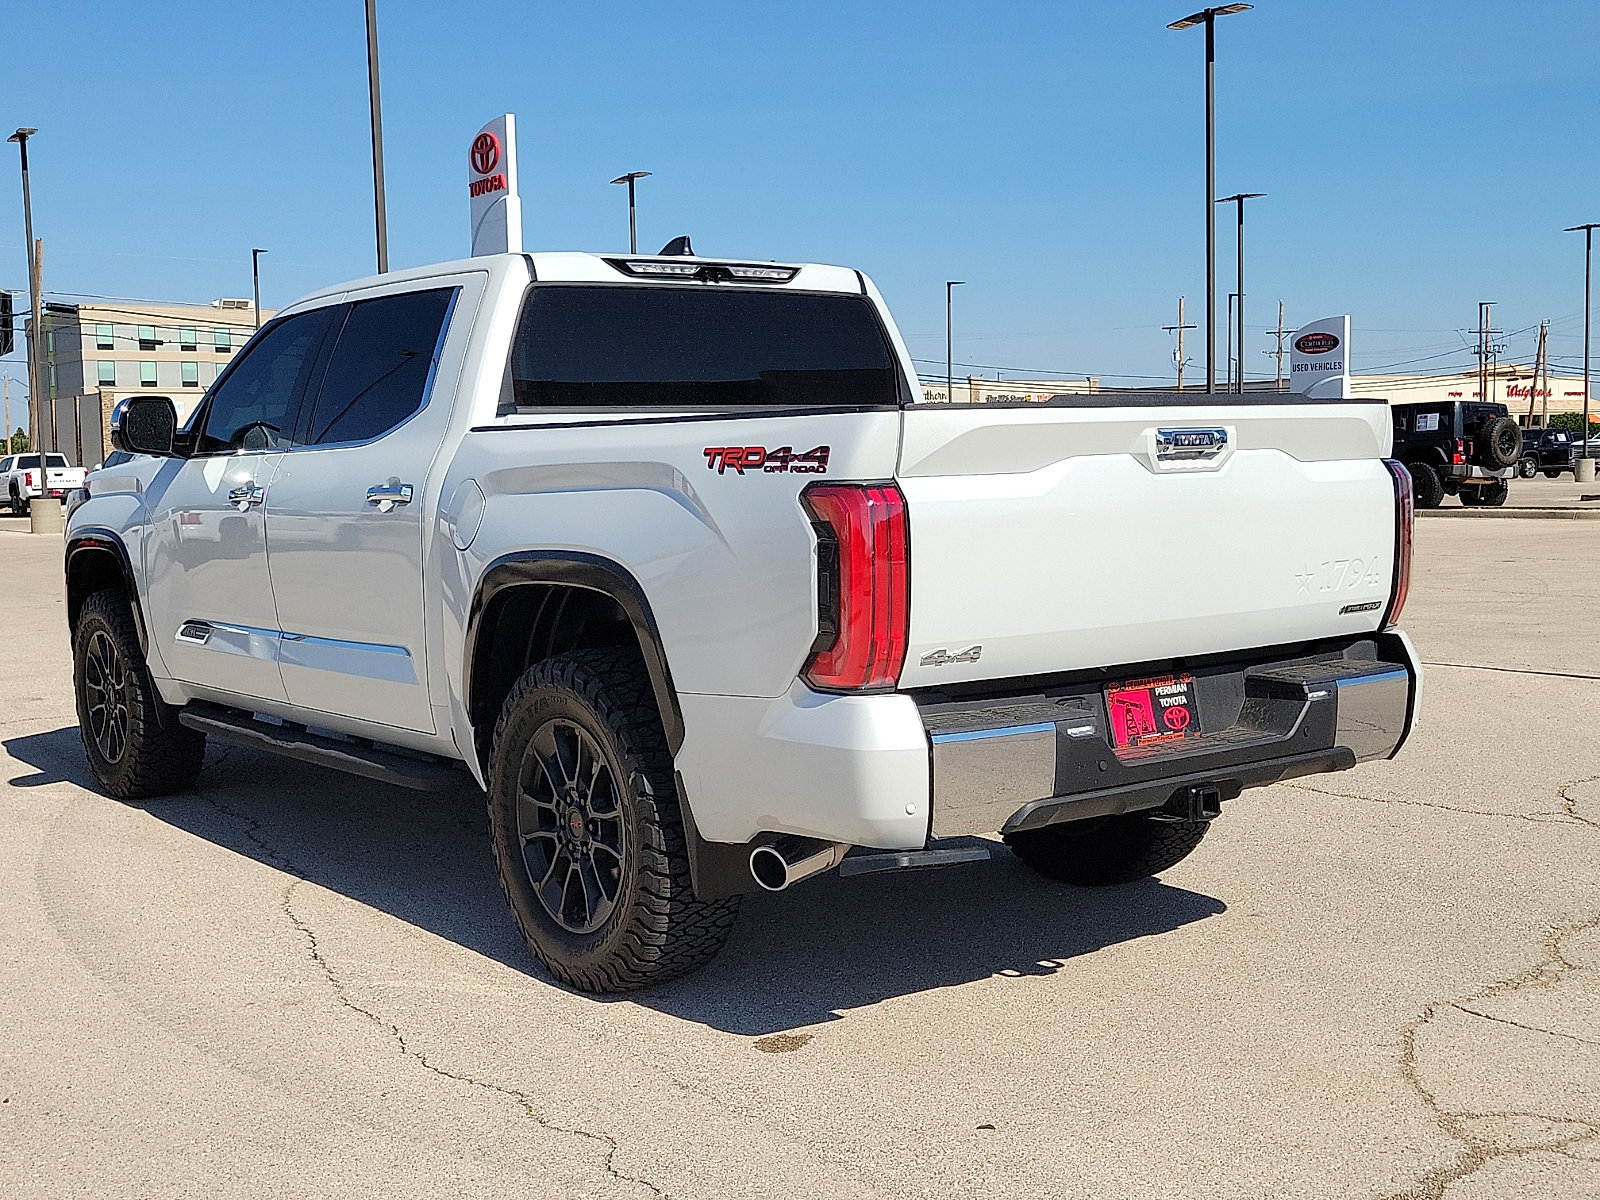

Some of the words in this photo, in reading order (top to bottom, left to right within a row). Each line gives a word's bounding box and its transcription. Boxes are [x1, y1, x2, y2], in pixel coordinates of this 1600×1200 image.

[469, 174, 507, 198] TOYOTA
[1292, 363, 1309, 373] USED
[1310, 361, 1343, 371] VEHICLES
[1505, 384, 1553, 401] Walgees
[1175, 433, 1213, 446] TOYOTA
[703, 446, 767, 475] TRD
[763, 465, 788, 473] OFF
[789, 465, 827, 473] ROAD
[1319, 556, 1380, 592] 1794
[1154, 683, 1188, 696] PERMIAN
[1159, 695, 1188, 708] TOYOTA
